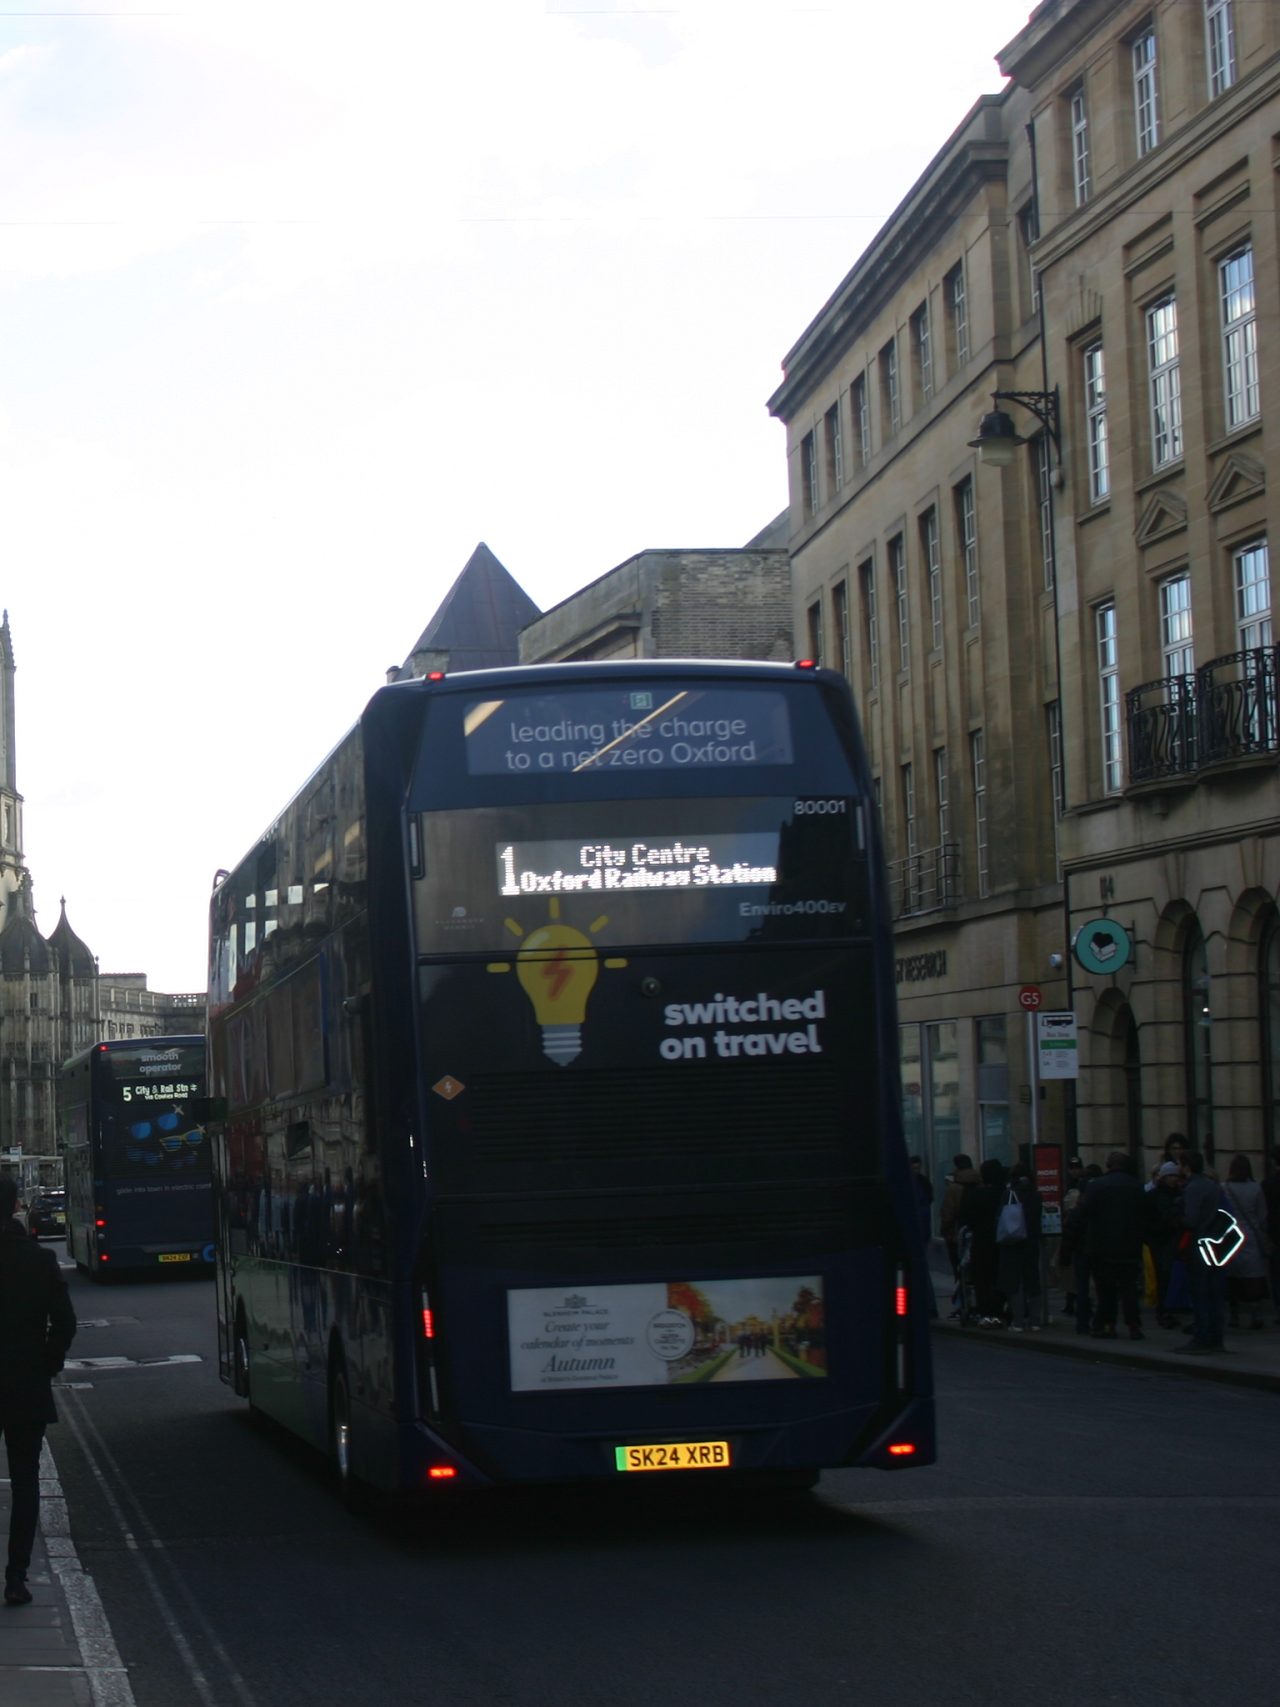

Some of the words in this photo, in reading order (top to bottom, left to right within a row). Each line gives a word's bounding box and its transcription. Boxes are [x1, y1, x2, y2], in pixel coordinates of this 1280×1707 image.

[510, 720, 605, 744] leading
[611, 718, 653, 739] the
[659, 716, 747, 739] charge
[505, 750, 529, 770] to
[538, 752, 555, 769] a
[562, 746, 602, 767] net
[609, 747, 664, 766] zero
[670, 740, 757, 764] Oxford
[794, 800, 847, 815] 80001
[580, 844, 626, 867] City
[632, 843, 711, 866] Centre
[500, 846, 520, 896] 1
[520, 869, 603, 893] Oxford
[605, 866, 690, 889] Railway
[692, 863, 777, 886] Station
[739, 899, 847, 917] Enviro400EV
[1020, 992, 1040, 1005] G5
[664, 990, 826, 1026] switched
[659, 1035, 707, 1060] on
[713, 1023, 823, 1058] travel
[141, 1051, 179, 1062] smooth
[139, 1063, 182, 1076] operator
[123, 1086, 133, 1101] 5
[135, 1085, 150, 1096] City
[152, 1084, 158, 1094] &
[160, 1083, 174, 1094] Rail
[176, 1083, 189, 1093] Stn
[545, 1320, 581, 1333] Create
[582, 1321, 610, 1333] your
[520, 1336, 570, 1350] calendar
[571, 1334, 586, 1352] of
[585, 1335, 635, 1347] moments
[541, 1354, 616, 1373] Autumn
[629, 1446, 680, 1467] SK24
[686, 1444, 725, 1464] XRB
